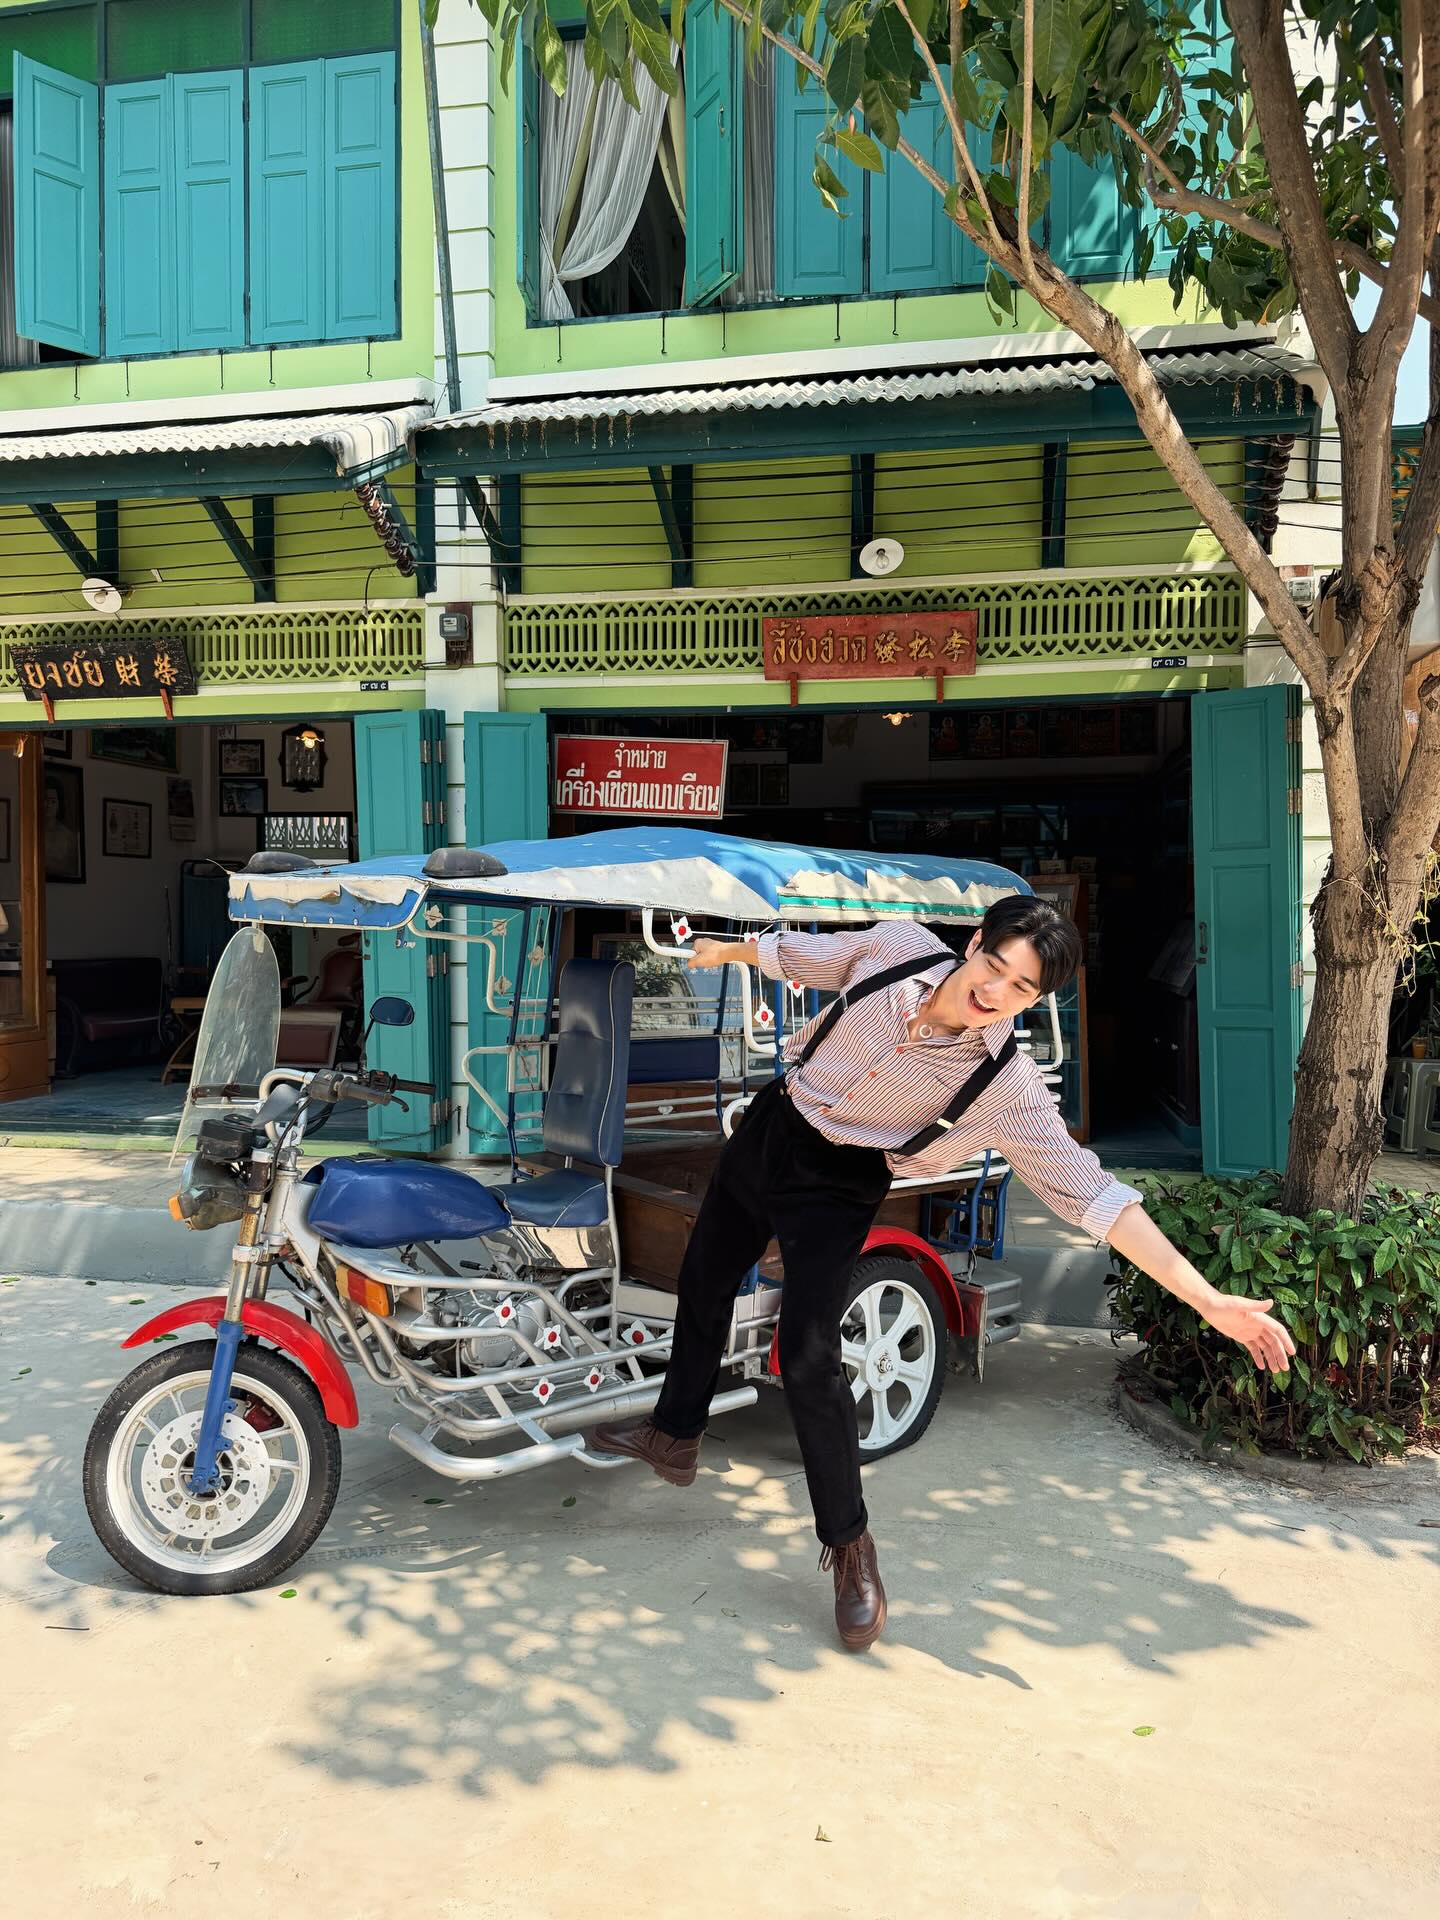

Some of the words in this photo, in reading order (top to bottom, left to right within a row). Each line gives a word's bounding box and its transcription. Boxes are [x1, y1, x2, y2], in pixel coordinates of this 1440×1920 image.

[614, 742, 667, 769] จำหน่าย
[556, 762, 720, 812] เครื่องเขียนแบบเรียน
